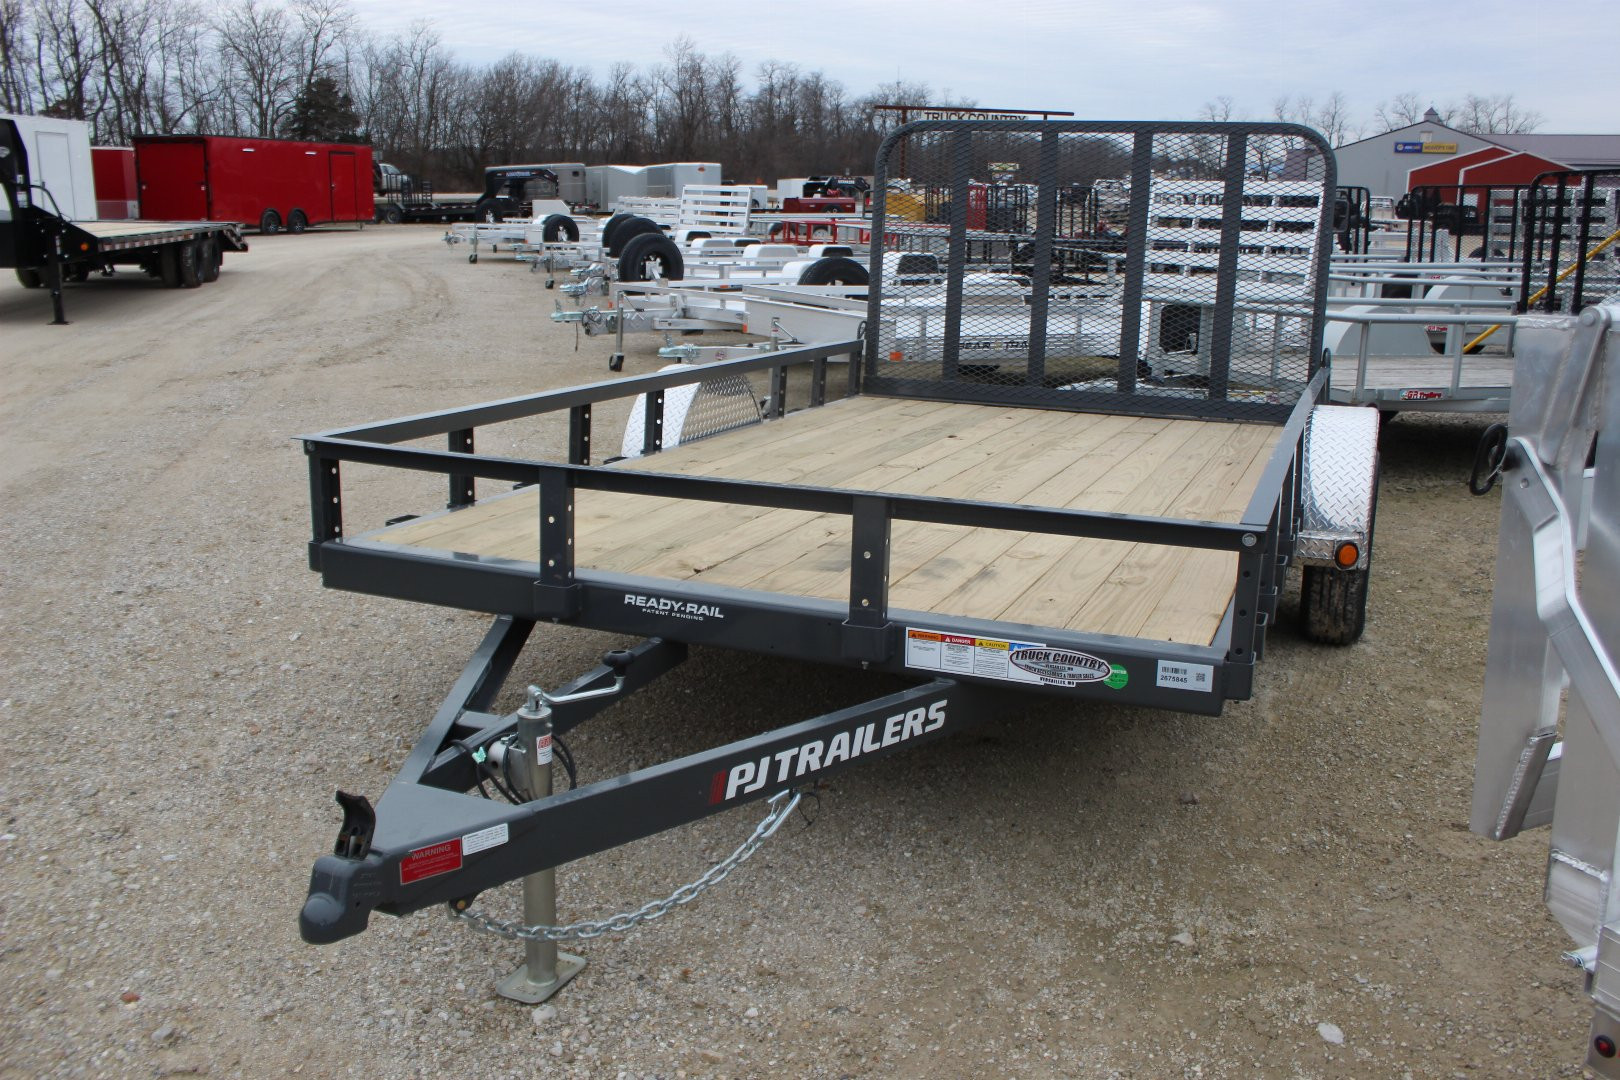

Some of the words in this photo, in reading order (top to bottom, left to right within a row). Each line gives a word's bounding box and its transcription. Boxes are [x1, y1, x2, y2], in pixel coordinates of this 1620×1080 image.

[924, 112, 965, 120] TRUCK
[624, 594, 724, 618] READY-RAIL
[642, 608, 669, 616] PATENT
[952, 637, 971, 645] DANGER
[1015, 650, 1050, 661] TRUCK
[1052, 652, 1105, 670] COUNTRY
[725, 756, 771, 800] PJ
[773, 700, 948, 783] TRAILERS
[411, 844, 452, 860] WARNING
